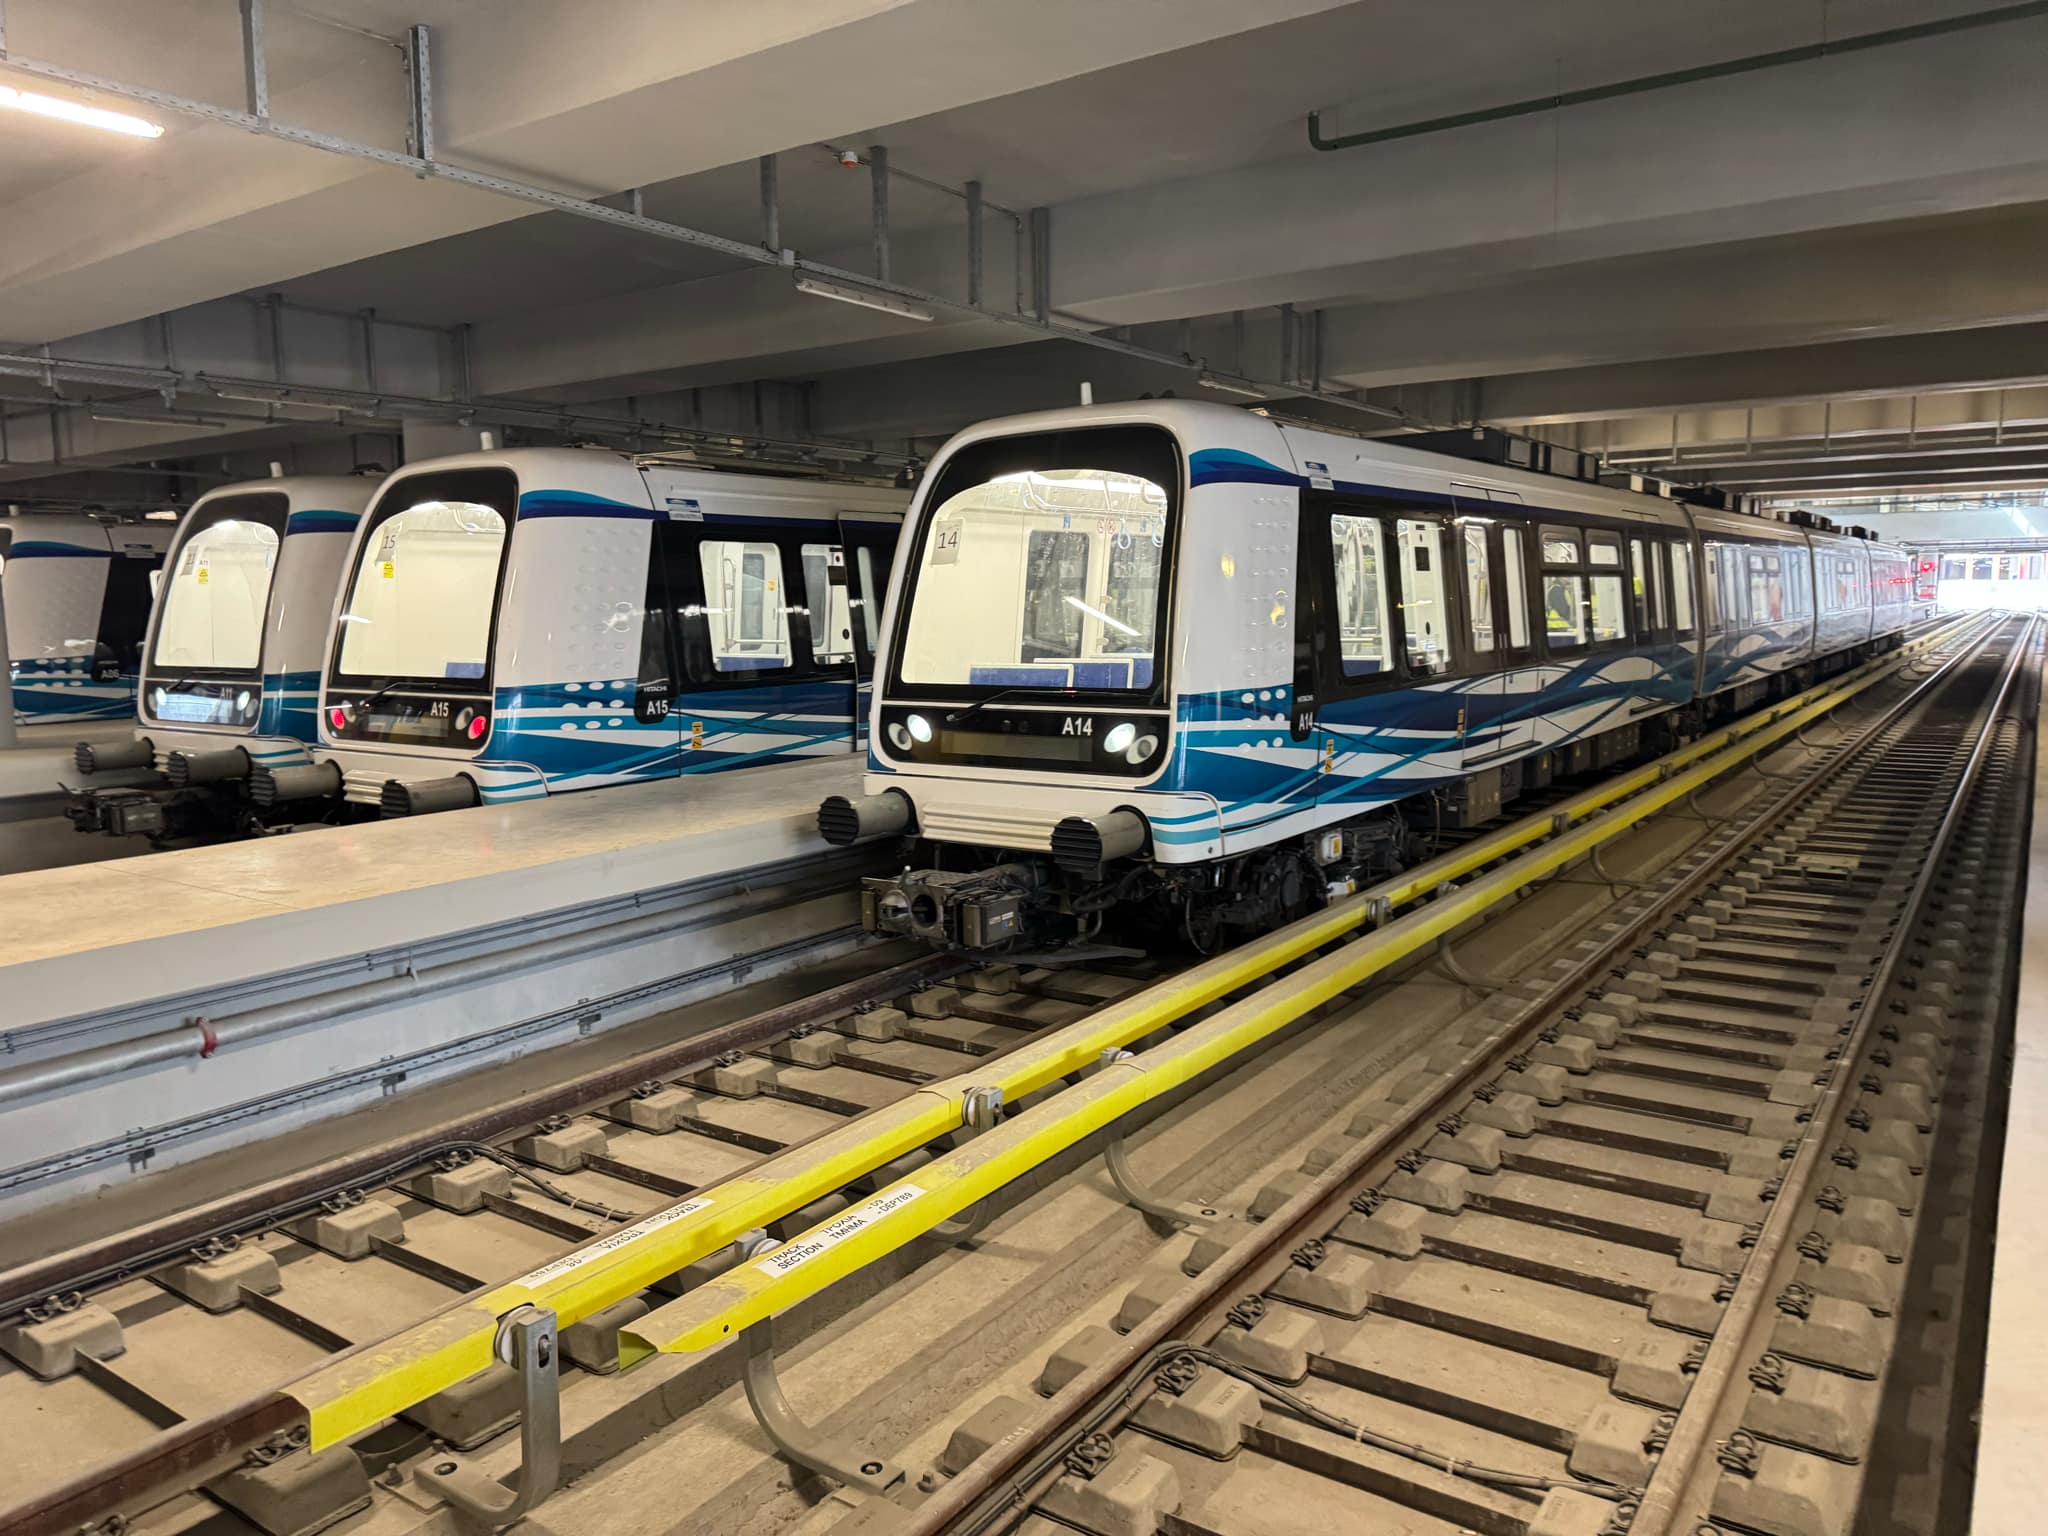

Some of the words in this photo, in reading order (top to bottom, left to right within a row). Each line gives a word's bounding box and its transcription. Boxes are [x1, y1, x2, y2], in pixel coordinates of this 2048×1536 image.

[383, 535, 396, 549] 15
[937, 531, 958, 549] 14
[430, 701, 449, 717] A15
[646, 700, 669, 715] A15
[1061, 717, 1093, 736] A14
[1299, 711, 1314, 731] A14
[768, 1243, 805, 1264] TRACK
[777, 1242, 824, 1270] SECTION
